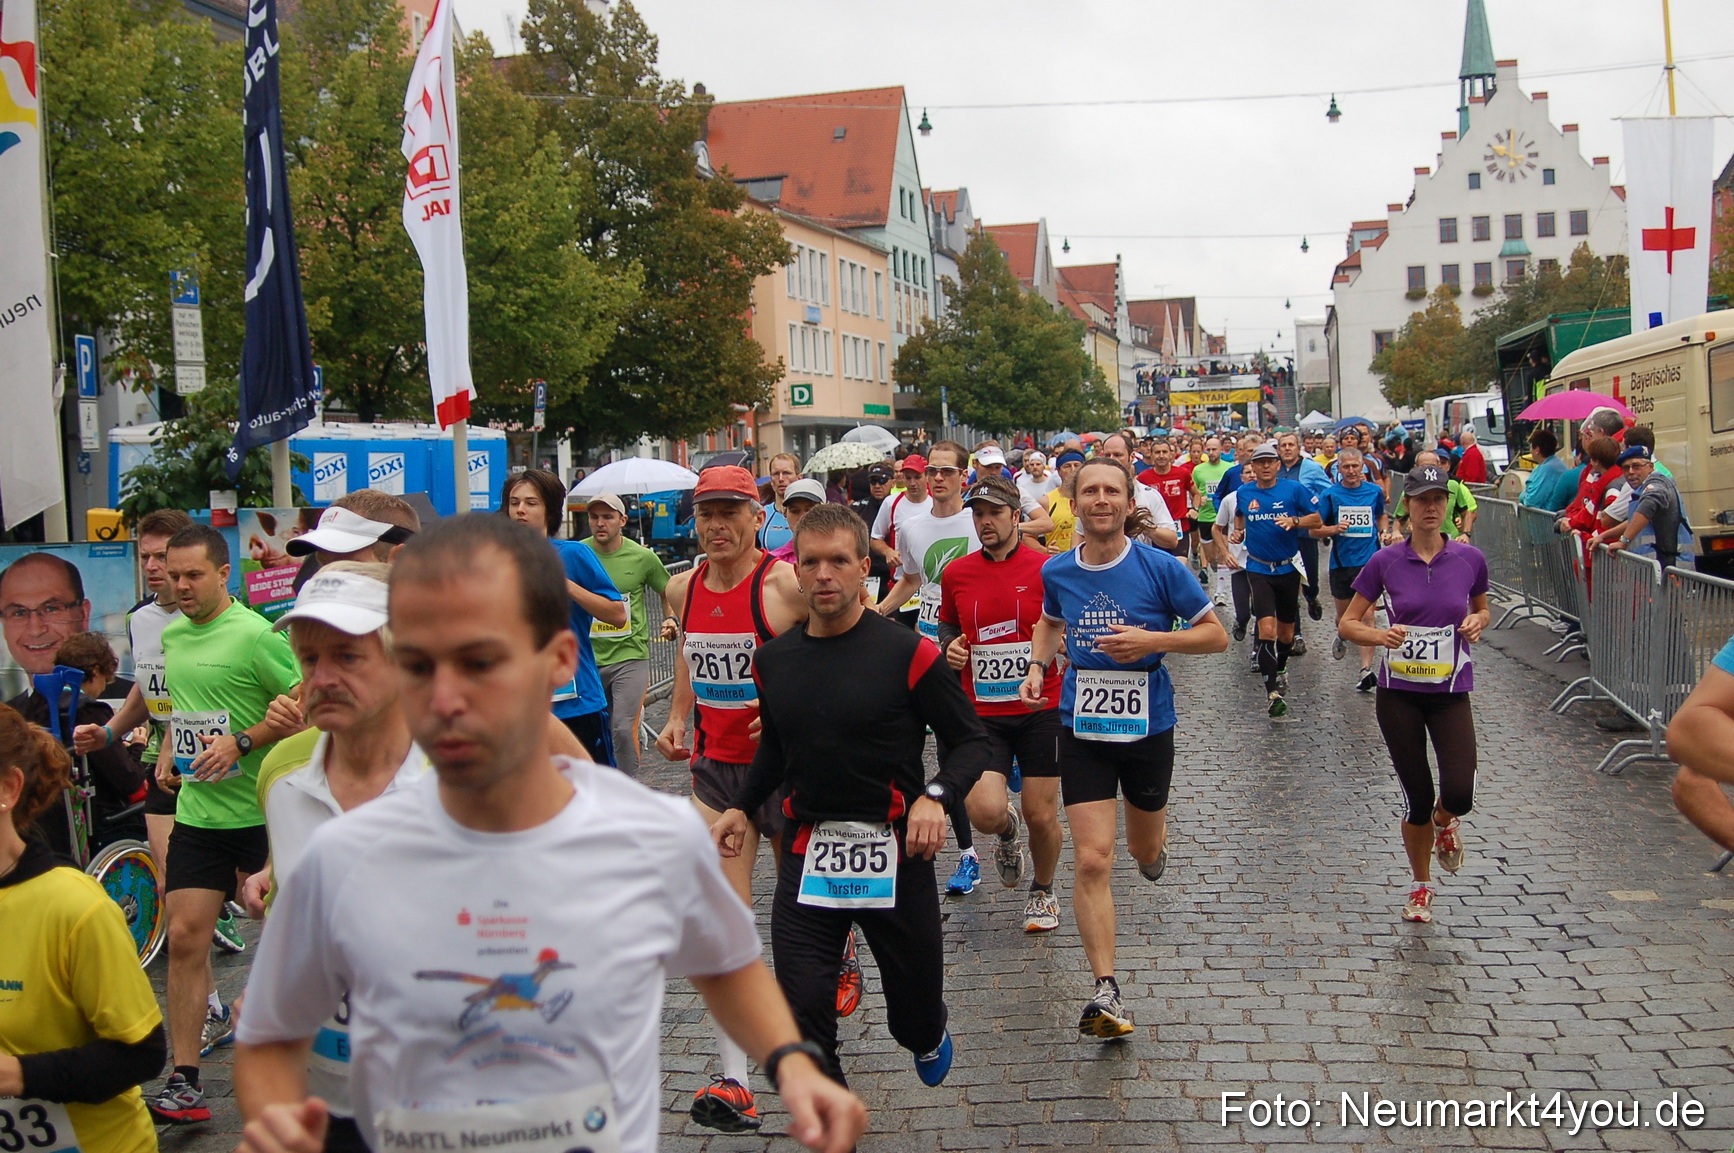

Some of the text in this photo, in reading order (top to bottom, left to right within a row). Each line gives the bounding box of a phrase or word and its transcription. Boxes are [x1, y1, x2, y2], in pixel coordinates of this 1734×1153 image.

[1630, 364, 1681, 393] Bayerisches
[793, 387, 810, 403] D
[1199, 393, 1230, 402] START
[1630, 395, 1655, 414] Rotes
[685, 641, 741, 649] PARTL Neumarkt
[991, 648, 1021, 656] Neumarkt
[1402, 639, 1439, 660] 321
[691, 652, 752, 680] 2612
[977, 656, 1028, 680] 2329
[1405, 665, 1436, 674] Kathrin
[1078, 677, 1135, 685] PARTL Neumarkt
[706, 686, 745, 698] Manfred
[158, 702, 172, 712] Oliv
[1081, 687, 1141, 715] 2256
[184, 718, 215, 726] Neumarkt
[1080, 720, 1140, 734] Hans-Jürgen
[835, 827, 878, 839] Neumarkt
[813, 841, 888, 873] 2565
[827, 881, 869, 895] Torsten
[477, 916, 529, 925] Sparkasse
[383, 1119, 574, 1149] PARTL Neumarkt
